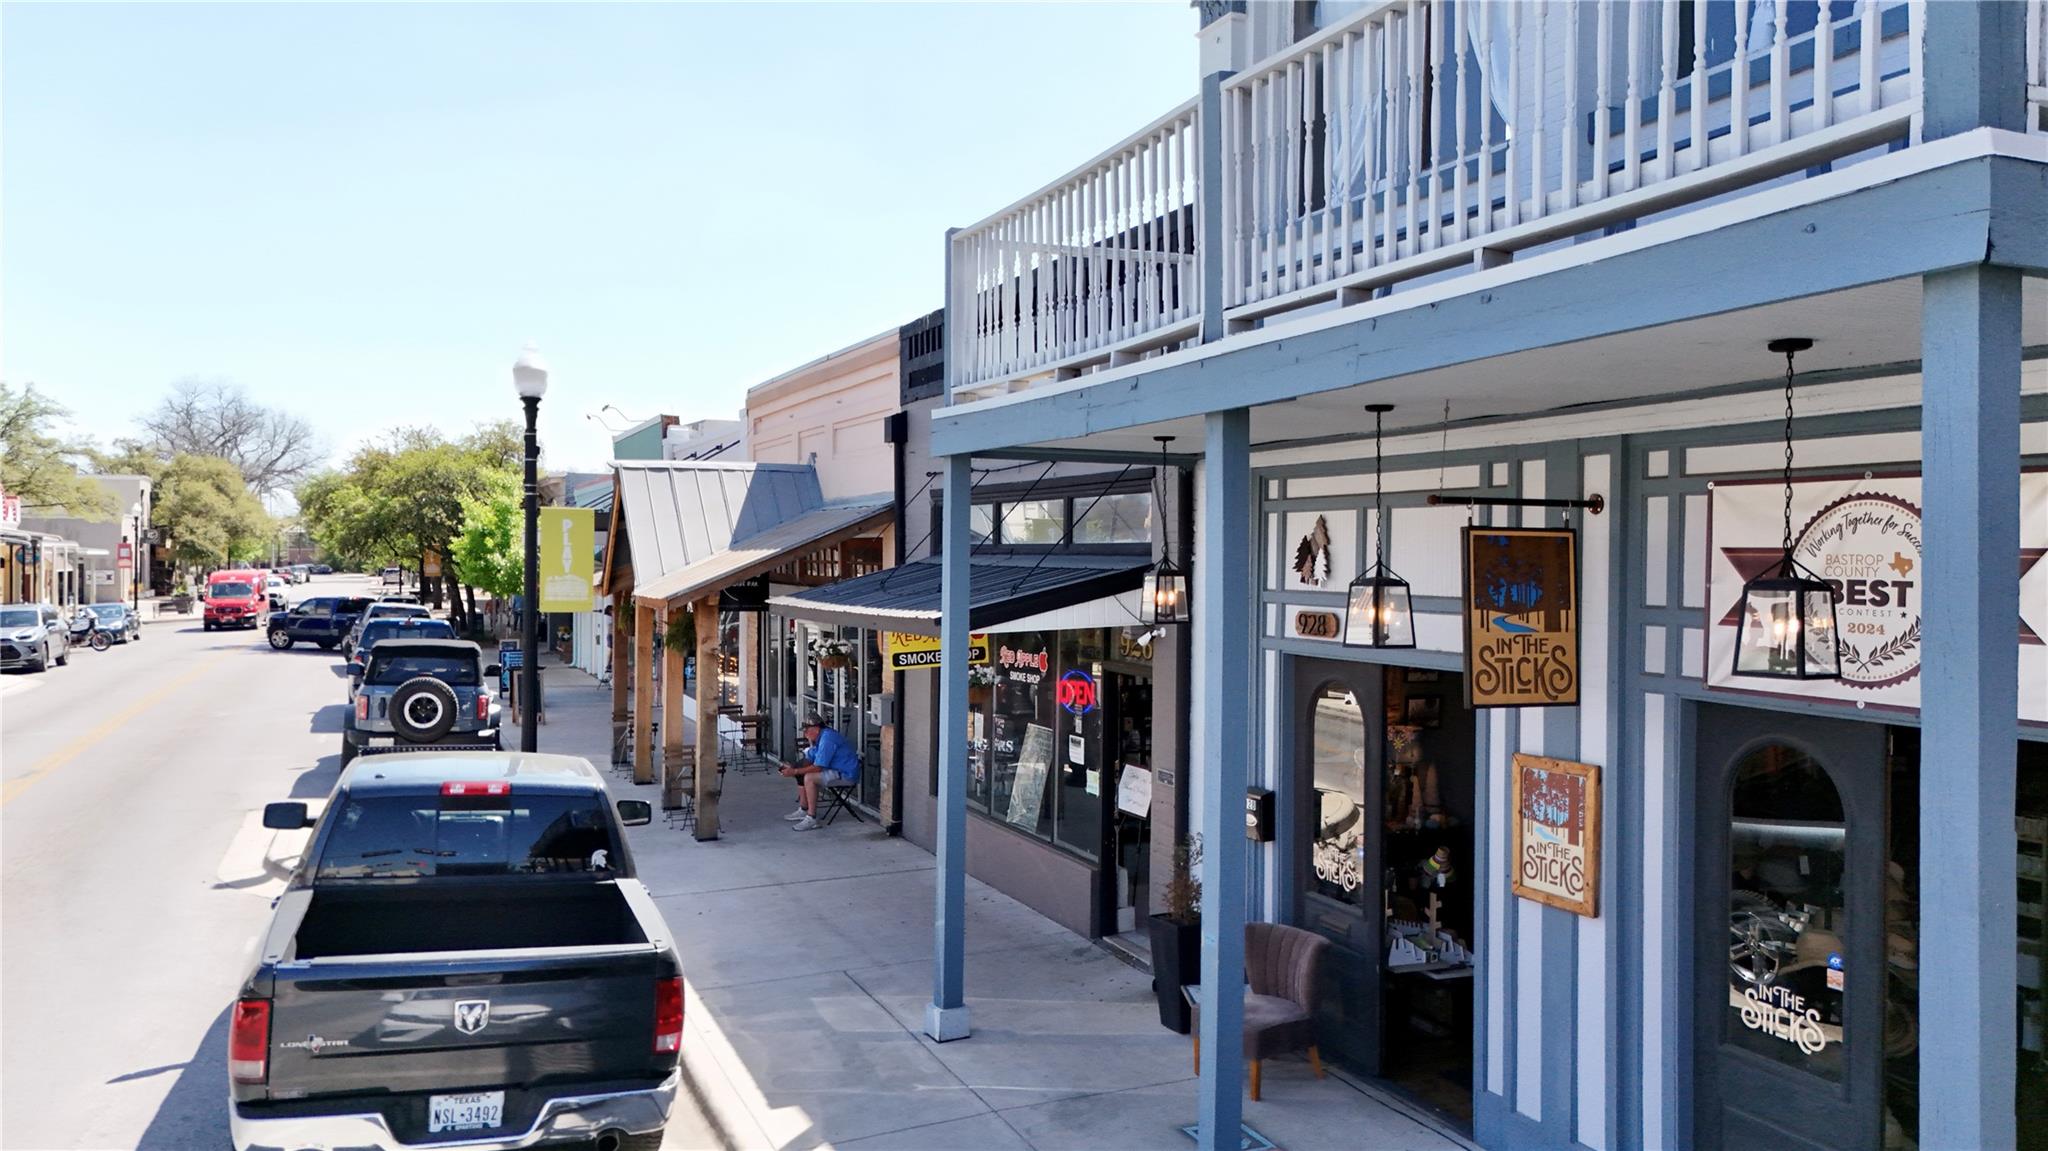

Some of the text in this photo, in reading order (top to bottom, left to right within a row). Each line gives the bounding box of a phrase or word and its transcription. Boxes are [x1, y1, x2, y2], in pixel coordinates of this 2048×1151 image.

[1805, 511, 1921, 558] Working Together for Succe
[1825, 554, 1884, 566] BASTROP
[1824, 566, 1880, 578] COUNTY
[1833, 578, 1914, 608] BEST
[1838, 608, 1892, 618] CONTEST
[1299, 613, 1327, 636] 928
[1847, 622, 1885, 635] 2024
[1496, 634, 1549, 656] IN THE
[899, 651, 942, 665] SMOKE
[1009, 671, 1041, 684] SMOKE SHOP
[1475, 645, 1573, 701] STICKS
[1056, 679, 1095, 706] OPEN
[1537, 842, 1571, 861] IN THE
[1316, 851, 1356, 892] STICKS
[1523, 844, 1585, 896] STICKS
[1758, 983, 1805, 1014] IN THE
[1740, 987, 1826, 1055] STICKS
[454, 1096, 481, 1104] TEXAS
